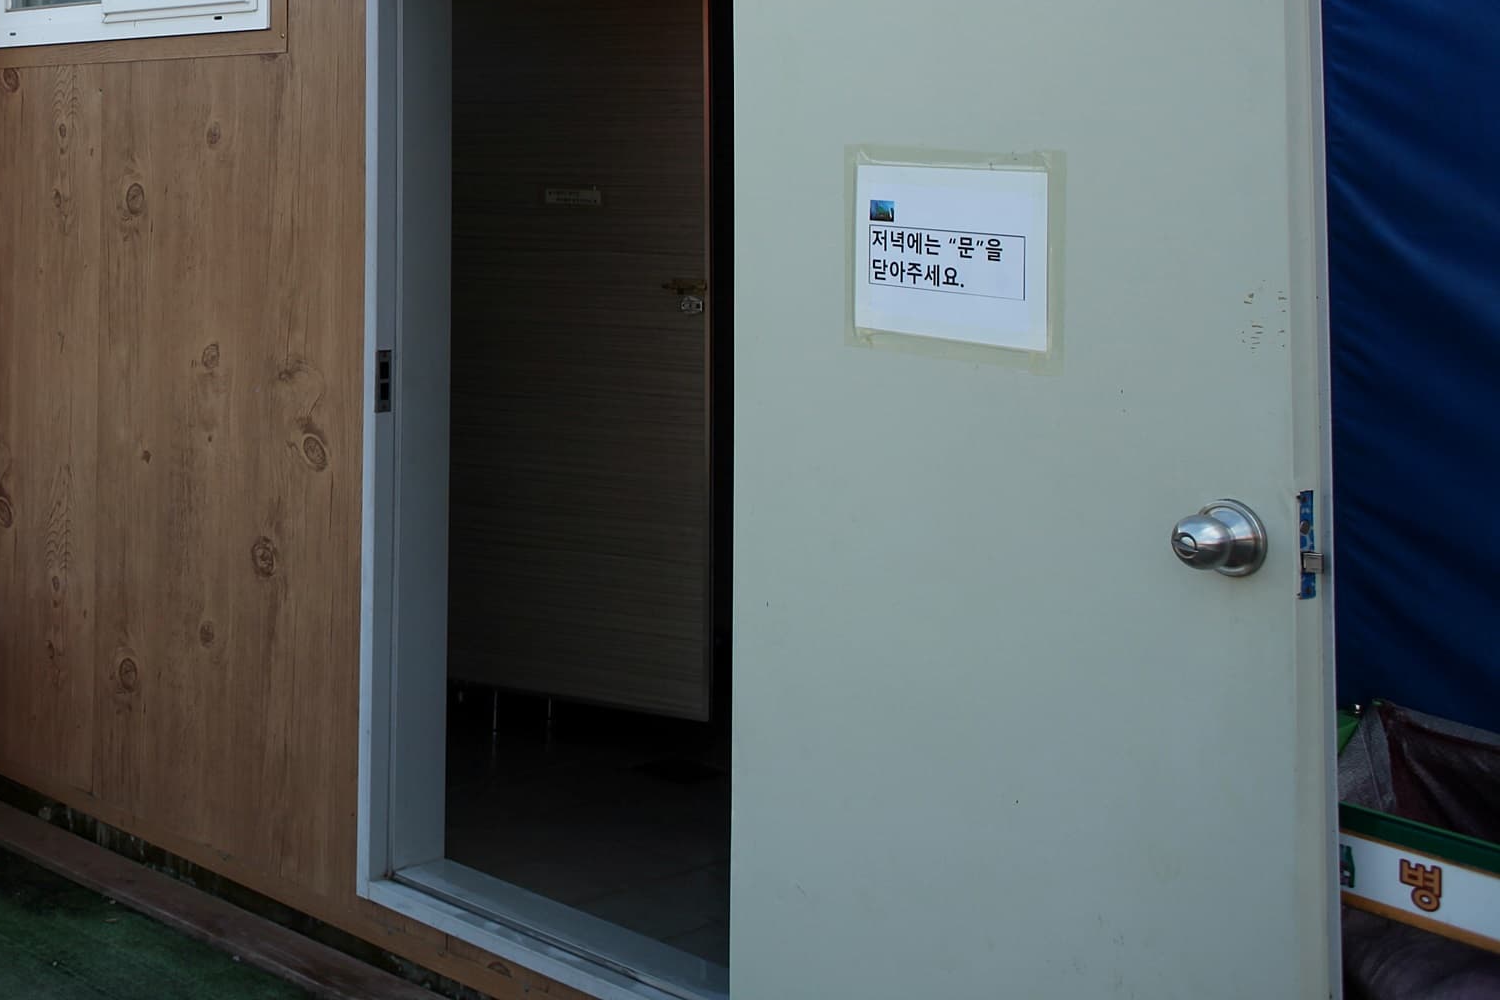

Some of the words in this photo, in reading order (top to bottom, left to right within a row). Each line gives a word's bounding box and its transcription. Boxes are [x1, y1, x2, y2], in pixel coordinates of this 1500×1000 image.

[872, 229, 941, 256] 저녁에는
[872, 259, 965, 288] 닫아주세요.
[1399, 858, 1442, 912] 병
